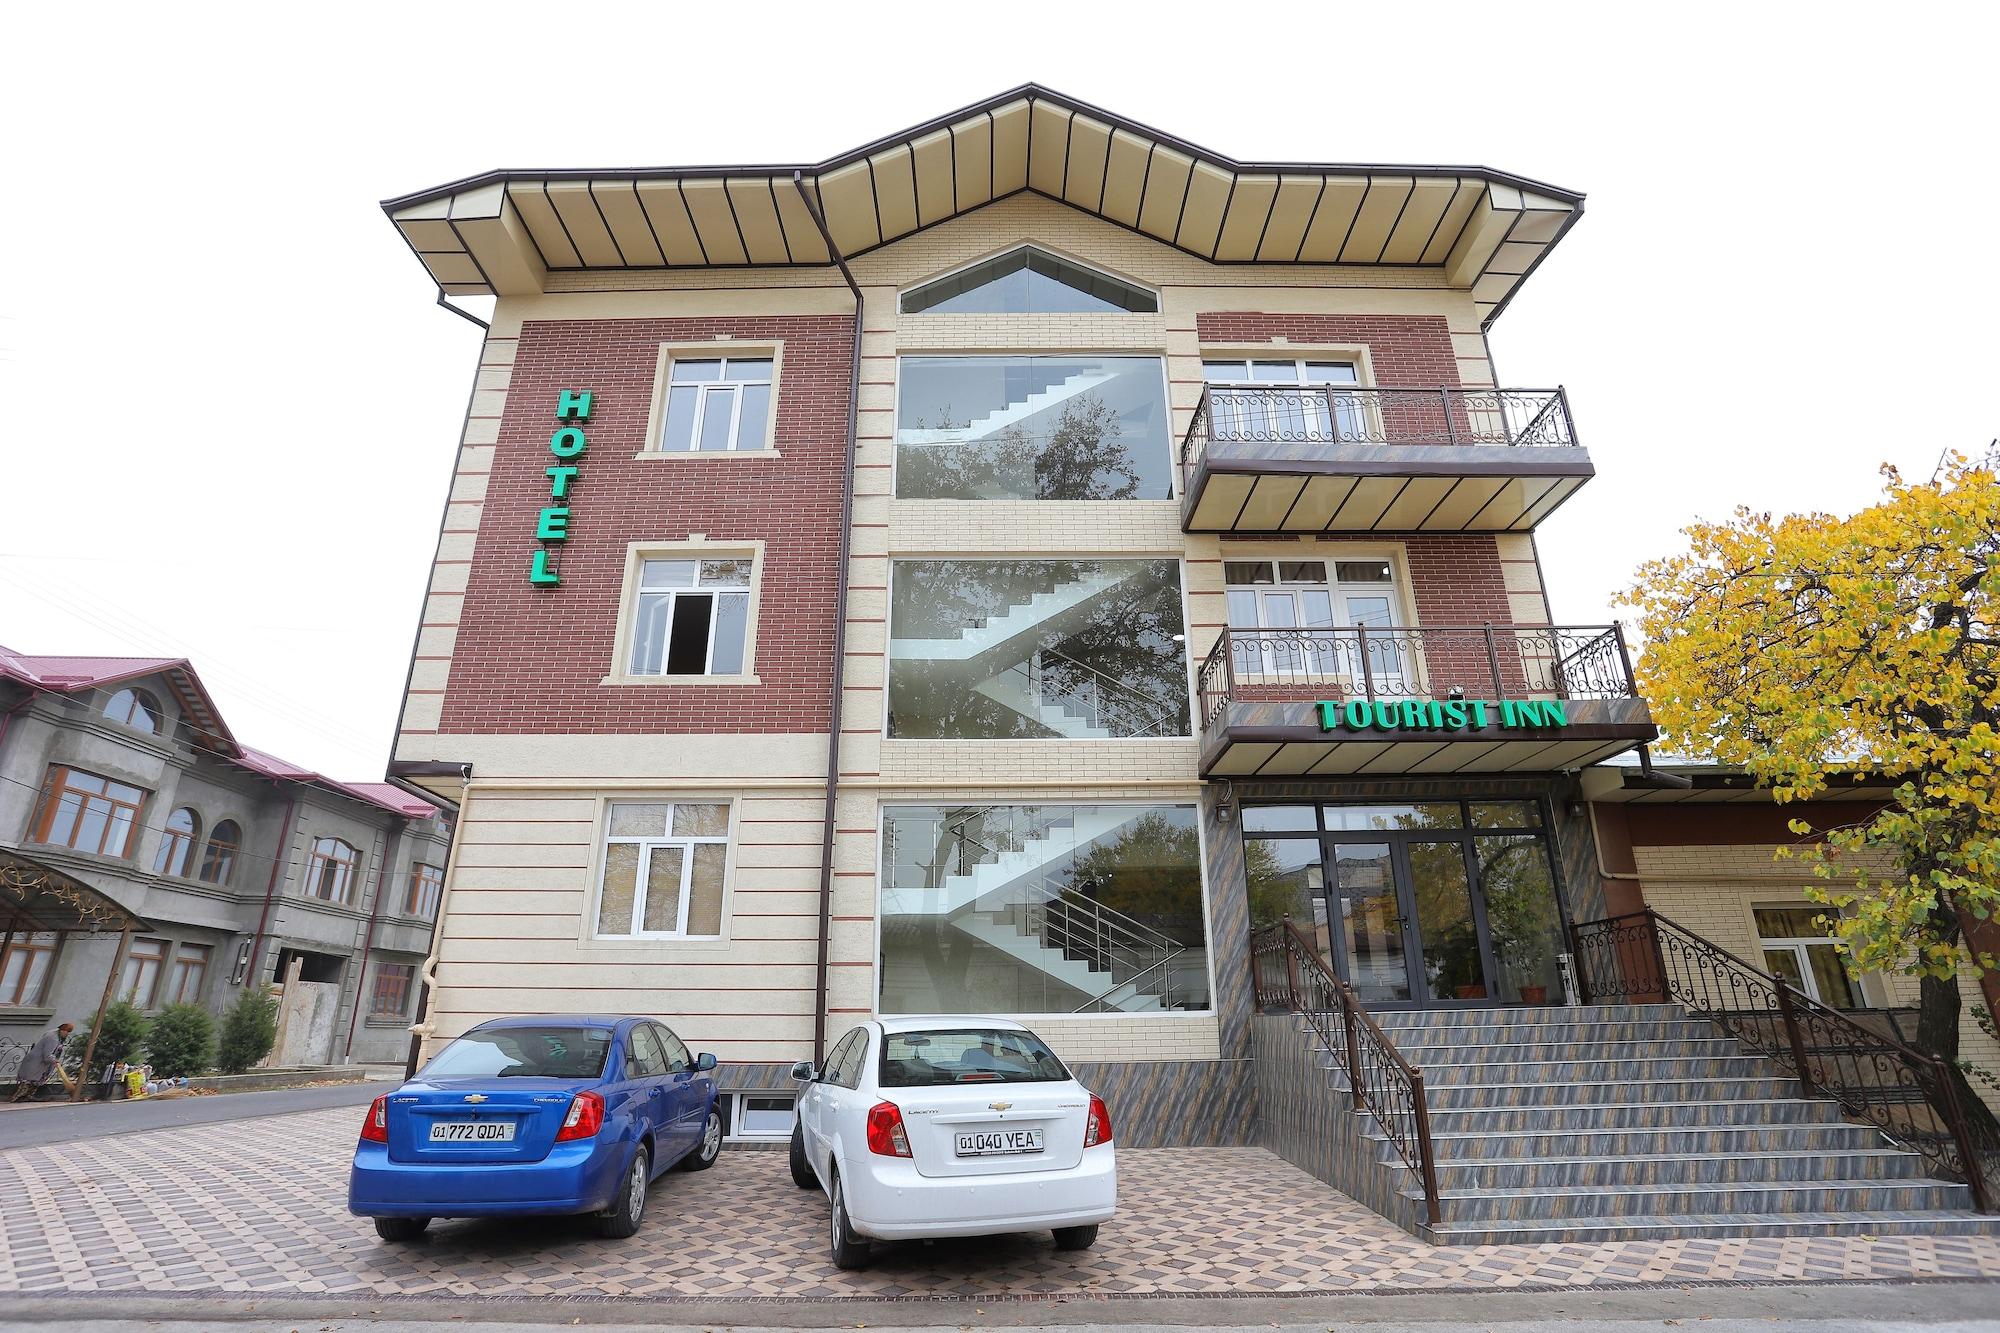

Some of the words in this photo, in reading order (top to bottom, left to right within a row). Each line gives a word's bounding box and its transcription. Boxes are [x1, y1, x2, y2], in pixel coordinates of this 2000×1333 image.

[529, 389, 594, 588] HOTEL
[1316, 700, 1488, 731] TOURIST
[1500, 700, 1568, 730] INN
[433, 1126, 446, 1138] 01
[449, 1125, 474, 1139] 772
[477, 1125, 505, 1139] QDA
[960, 1137, 974, 1149] 01
[976, 1134, 1002, 1150] 040
[1005, 1132, 1035, 1148] YEA
